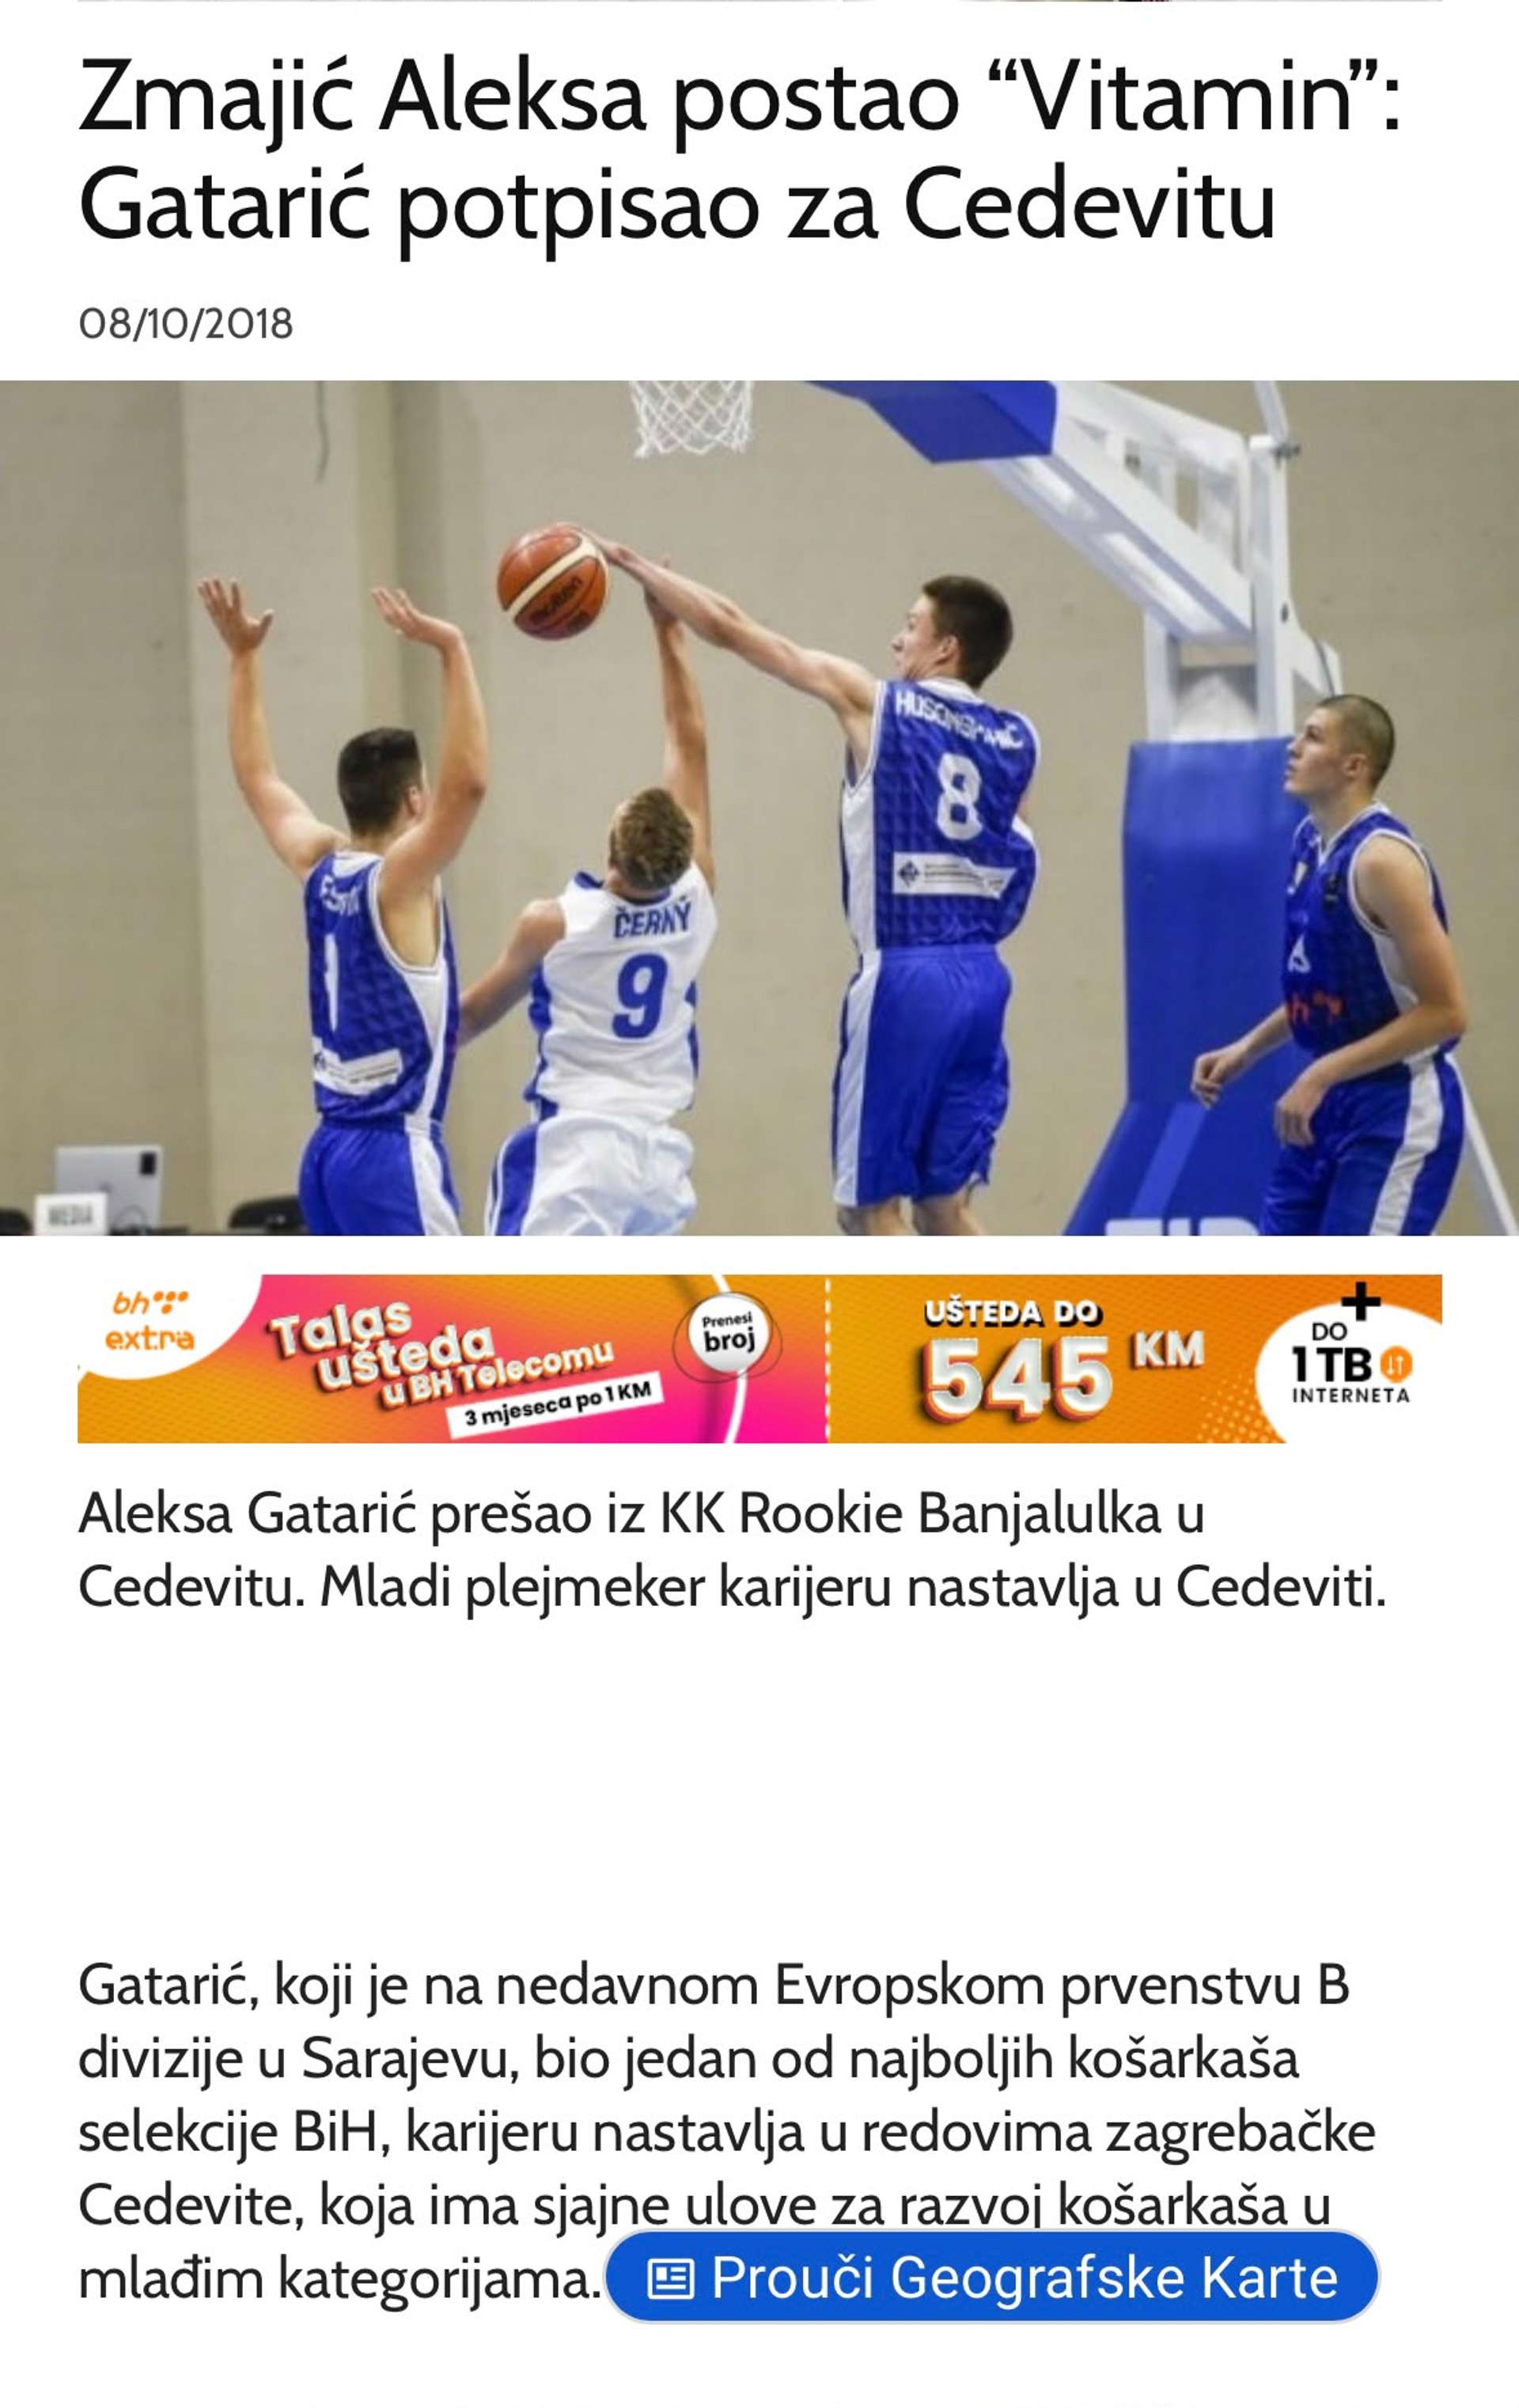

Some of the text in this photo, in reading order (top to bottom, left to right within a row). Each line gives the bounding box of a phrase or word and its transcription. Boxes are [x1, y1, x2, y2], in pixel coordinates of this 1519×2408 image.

[79, 54, 1398, 150] Zmajić Aleksa postao “Vitamin”:
[81, 162, 1272, 262] Gatarić potpisao za Cedevitu
[80, 307, 293, 343] 08/10/2018
[937, 752, 983, 841] 8
[615, 894, 691, 938] ČERNÝ
[612, 952, 669, 1039] 9
[113, 1291, 150, 1314] bh
[269, 1301, 412, 1357] Talas
[703, 1311, 752, 1328] Prenesi
[926, 1294, 1102, 1326] UŠTEDA DO
[105, 1325, 195, 1350] extra
[318, 1325, 495, 1390] ušteda
[704, 1327, 755, 1353] broj
[1312, 1322, 1348, 1341] DO
[382, 1341, 615, 1407] u BH Telecomu
[924, 1331, 1205, 1422] 545 KM
[1293, 1346, 1372, 1382] 1 TB
[465, 1380, 652, 1426] 3 mjeseca po 1 KM
[1293, 1388, 1410, 1403] INTERNETA
[78, 1489, 1203, 1547] Aleksa Gatarić prešao iz KK Rookie Banjalulka u
[80, 1562, 1385, 1620] Cedevitu. Mladi plejmeker karijeru nastavlja u Cedeviti.
[80, 1960, 1349, 2018] Gatarić, koji je na nedavnom Evropskom prvenstvu B
[80, 2034, 1299, 2092] divizije u Sarajevu, bio jedan od najboljih košarkaša
[80, 2107, 1375, 2165] selekcije BiH, karijeru nastavlja u redovima zagrebačke
[80, 2180, 1329, 2238] Cedevite, koja ima sjajne ulove za razvoj košarkaša u
[81, 2255, 600, 2311] mlađim kategorijama.
[715, 2254, 1336, 2309] Prouči Geografske Karte
